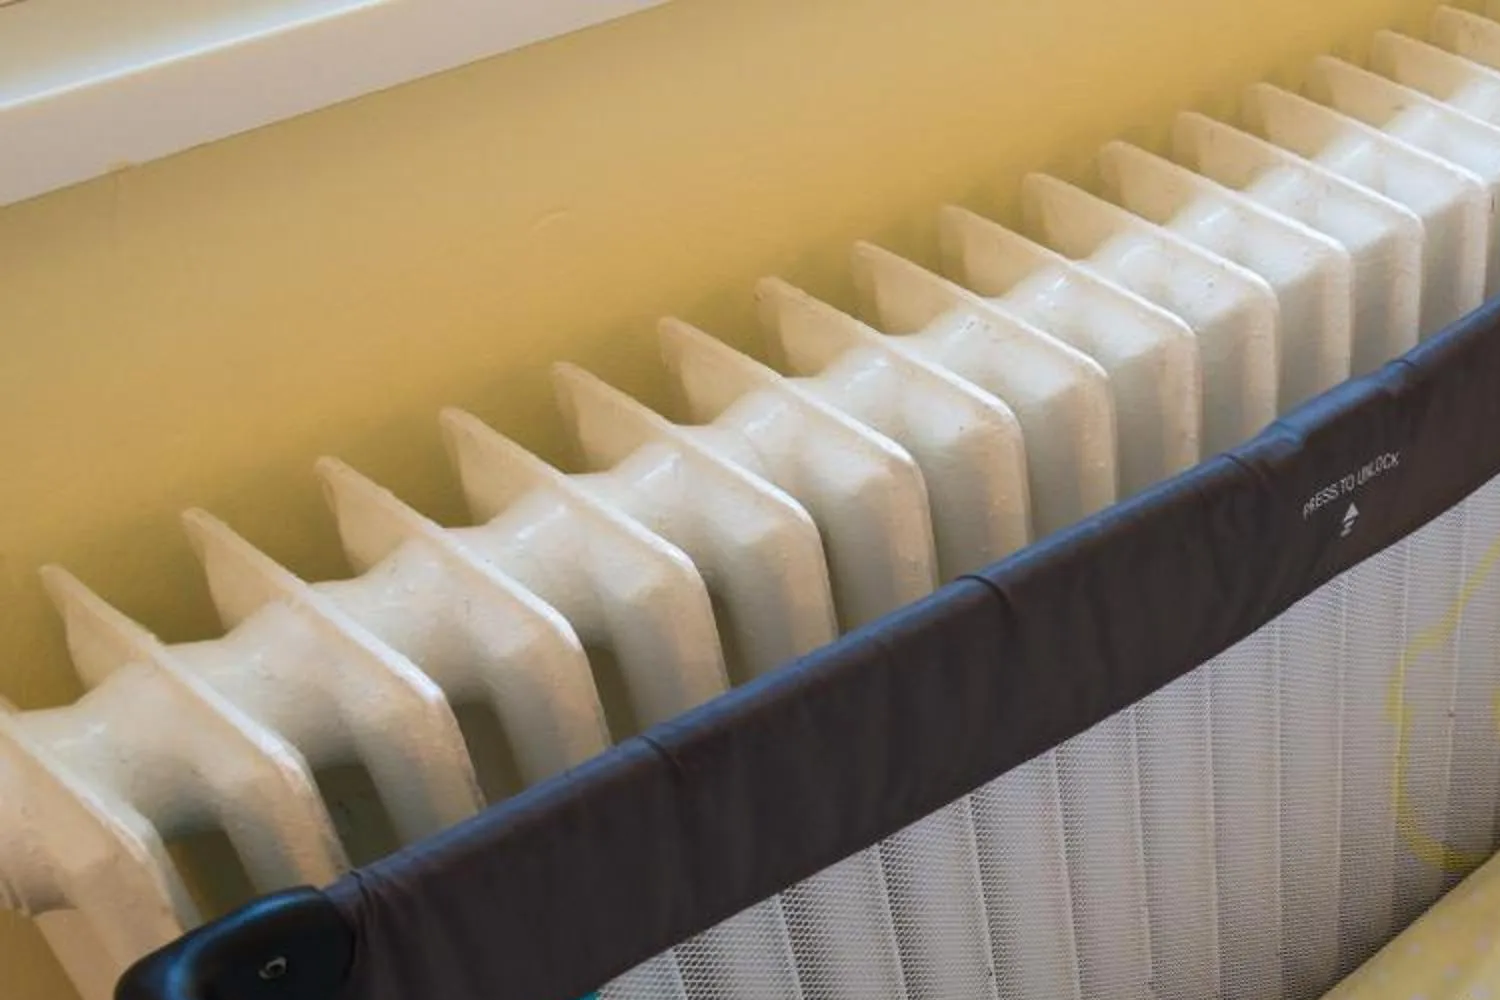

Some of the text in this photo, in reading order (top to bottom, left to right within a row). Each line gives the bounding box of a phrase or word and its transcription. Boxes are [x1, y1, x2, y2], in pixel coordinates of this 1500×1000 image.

[1302, 451, 1400, 520] PRESS TO UNLOCK
